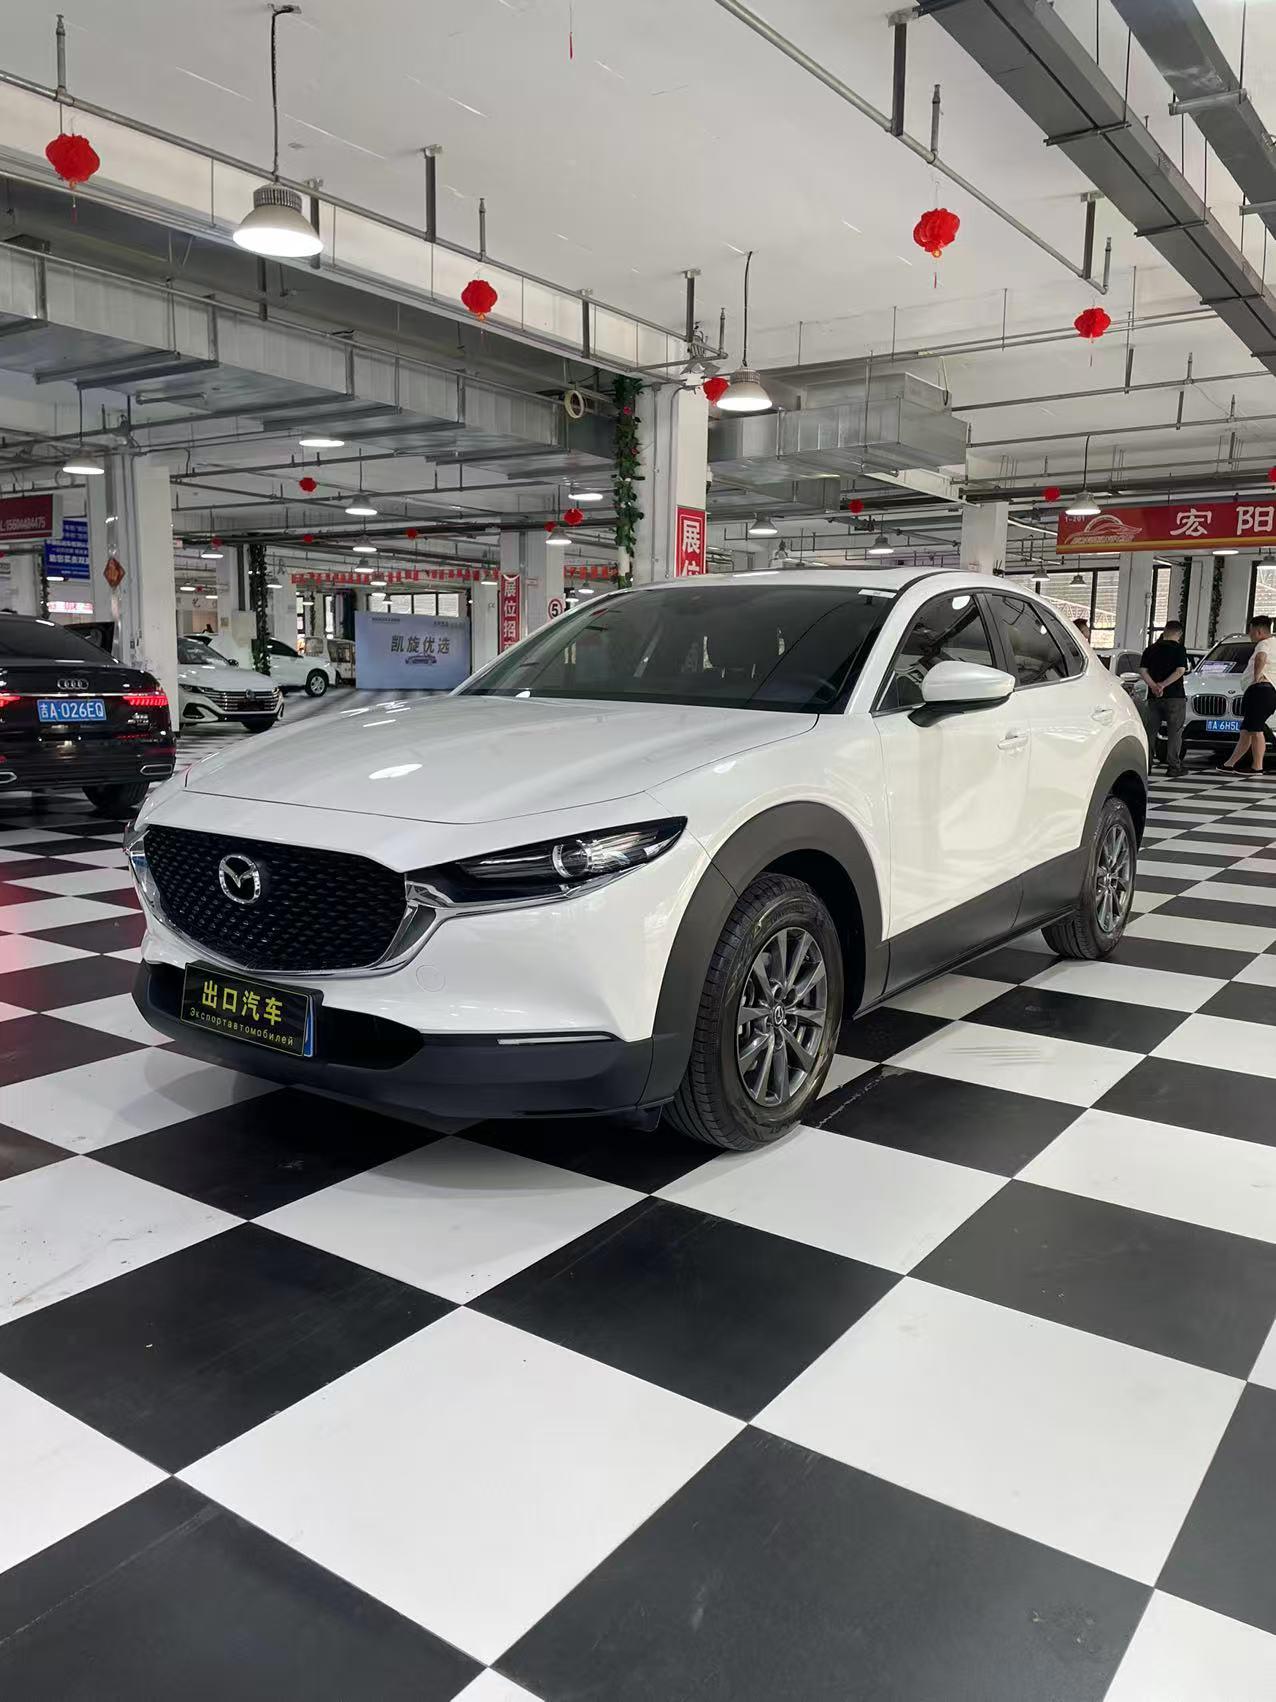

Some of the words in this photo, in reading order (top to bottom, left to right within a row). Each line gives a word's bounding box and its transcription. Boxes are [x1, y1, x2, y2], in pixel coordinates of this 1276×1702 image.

[551, 603, 559, 617] 5
[390, 635, 451, 655] 凯旋优选
[201, 980, 283, 1026] 出口汽车
[189, 1007, 295, 1046] Экспортавтомобилей
